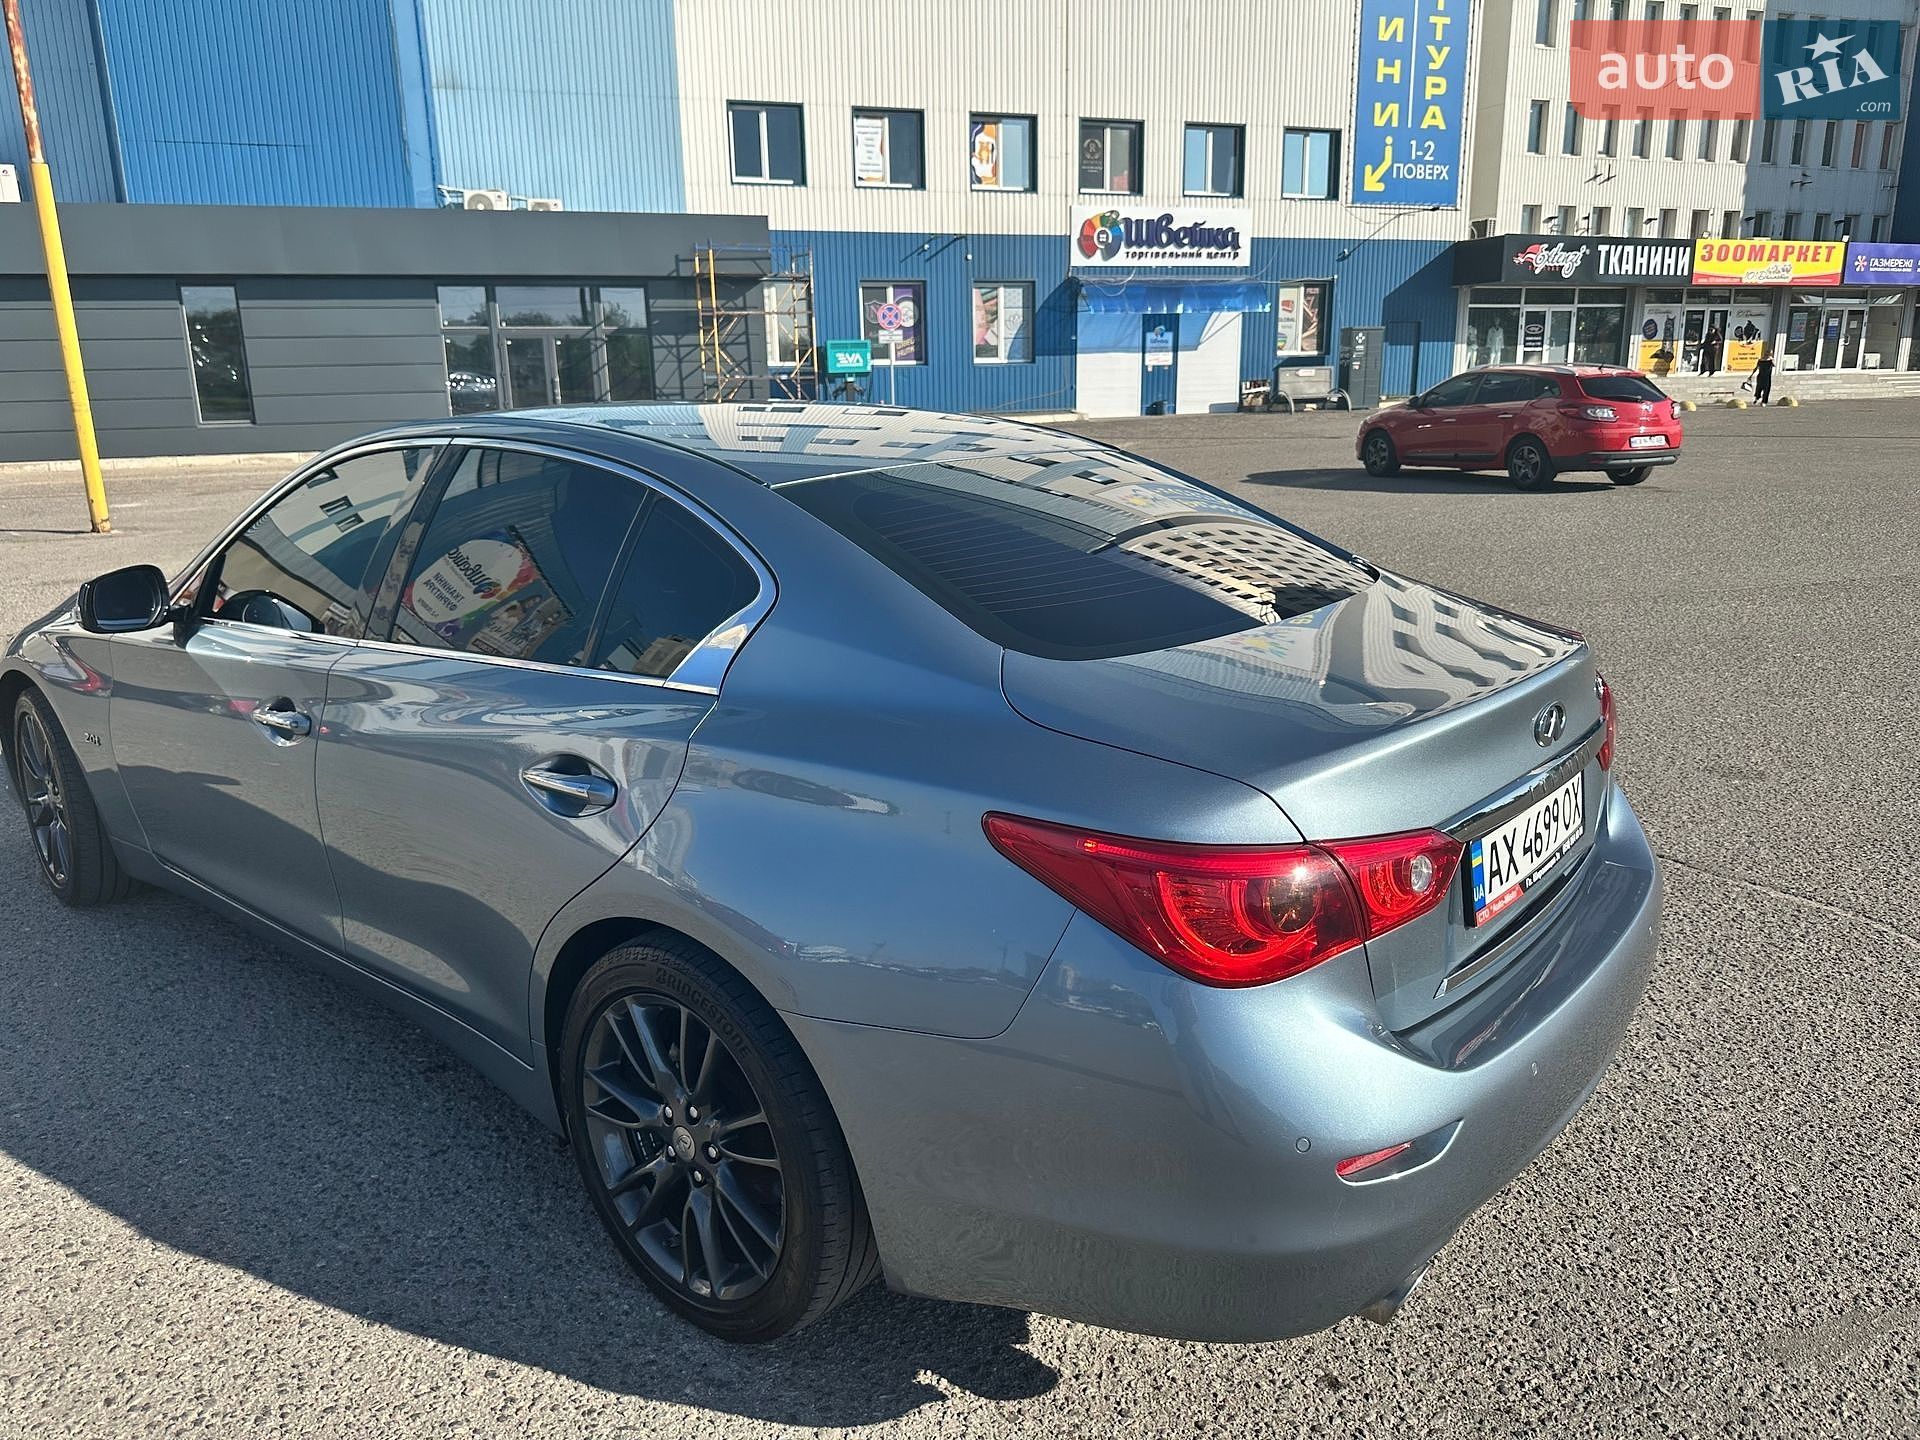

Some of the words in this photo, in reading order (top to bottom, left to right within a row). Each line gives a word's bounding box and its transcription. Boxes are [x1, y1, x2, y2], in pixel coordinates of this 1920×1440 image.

[1410, 140, 1435, 161] 1-2
[1393, 163, 1450, 181] ПОВЕРХ
[1122, 213, 1241, 250] Швейка
[1125, 251, 1202, 260] торгівельний
[1206, 251, 1240, 260] центр
[1597, 245, 1691, 276] ТКАНИНИ
[1700, 244, 1836, 262] ЗООМАРКЕТ
[835, 352, 864, 364] EVA
[1488, 826, 1520, 894] AX
[1522, 797, 1560, 863] 4699
[1562, 776, 1581, 831] OX
[1473, 884, 1485, 902] UA
[655, 966, 750, 1058] BRIDGESTONE
